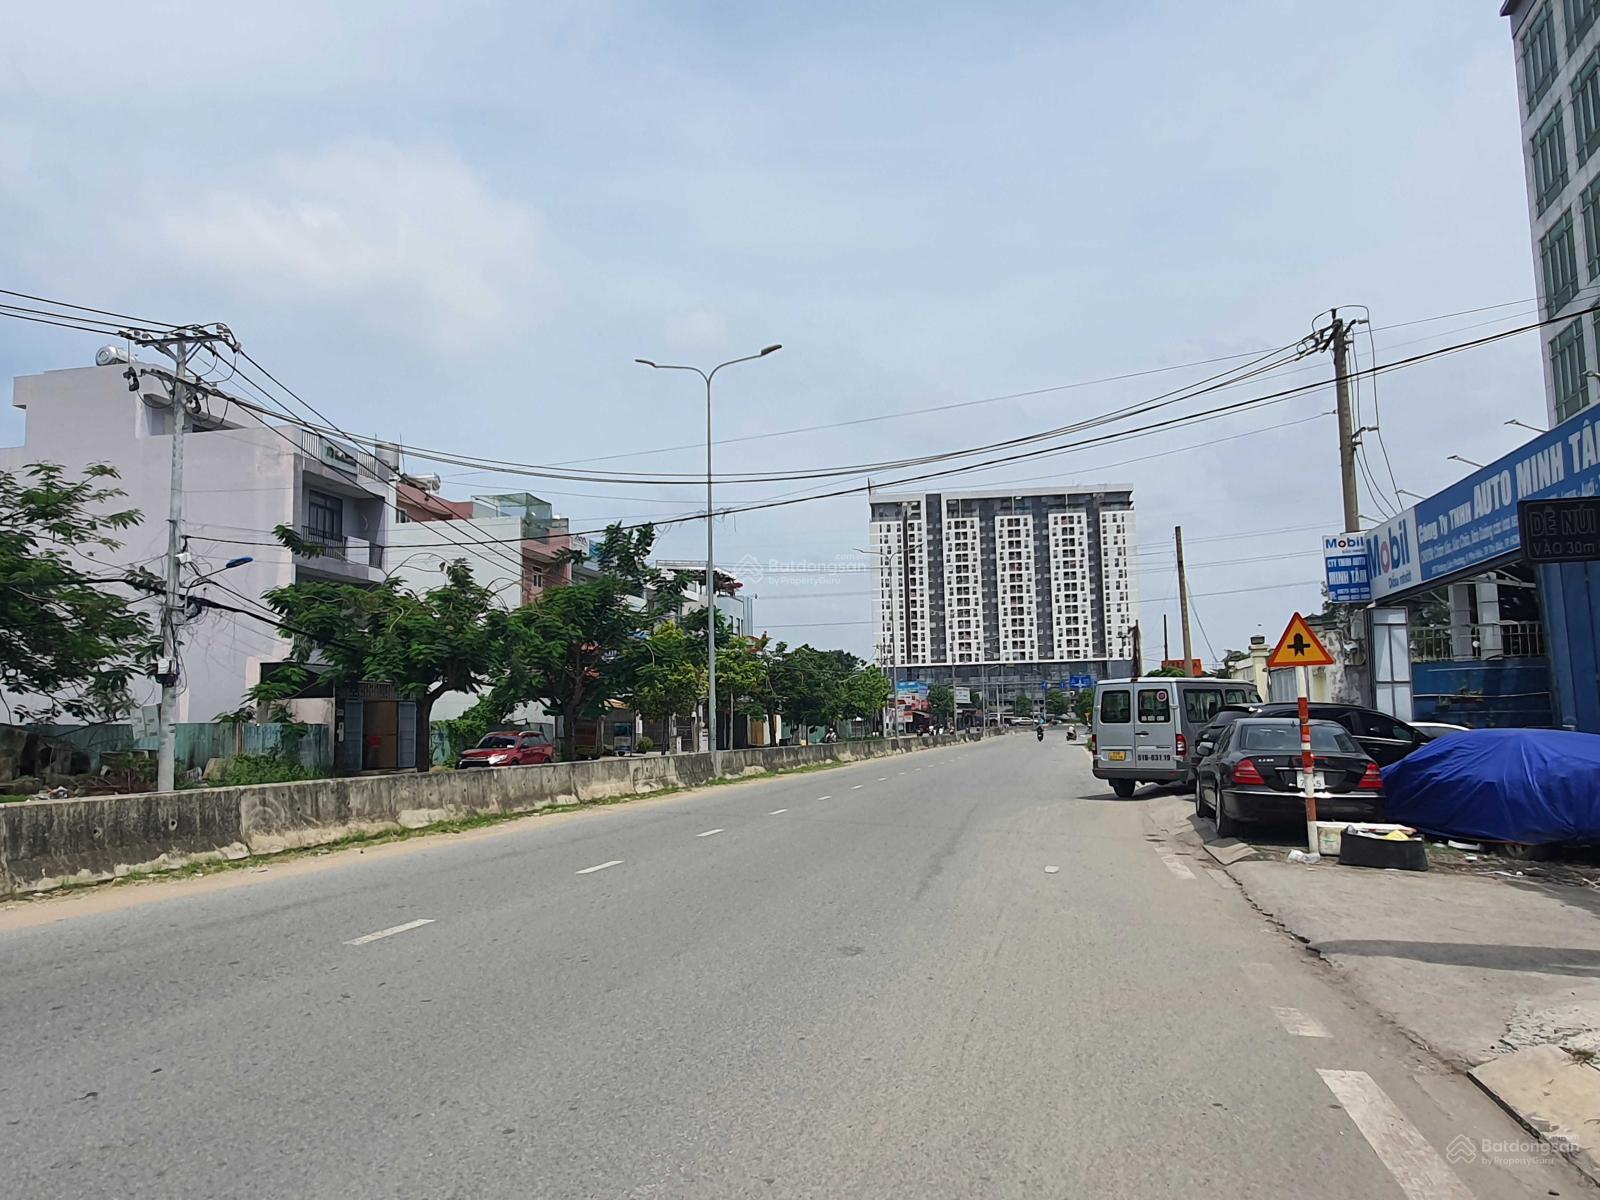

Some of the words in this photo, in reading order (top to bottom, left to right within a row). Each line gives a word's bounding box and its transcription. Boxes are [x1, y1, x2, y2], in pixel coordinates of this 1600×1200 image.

[1473, 470, 1512, 519] AUTO
[1515, 441, 1565, 499] MINH
[1325, 536, 1364, 549] Mobil
[1366, 519, 1410, 580] Mobil
[1567, 541, 1595, 554] 30m
